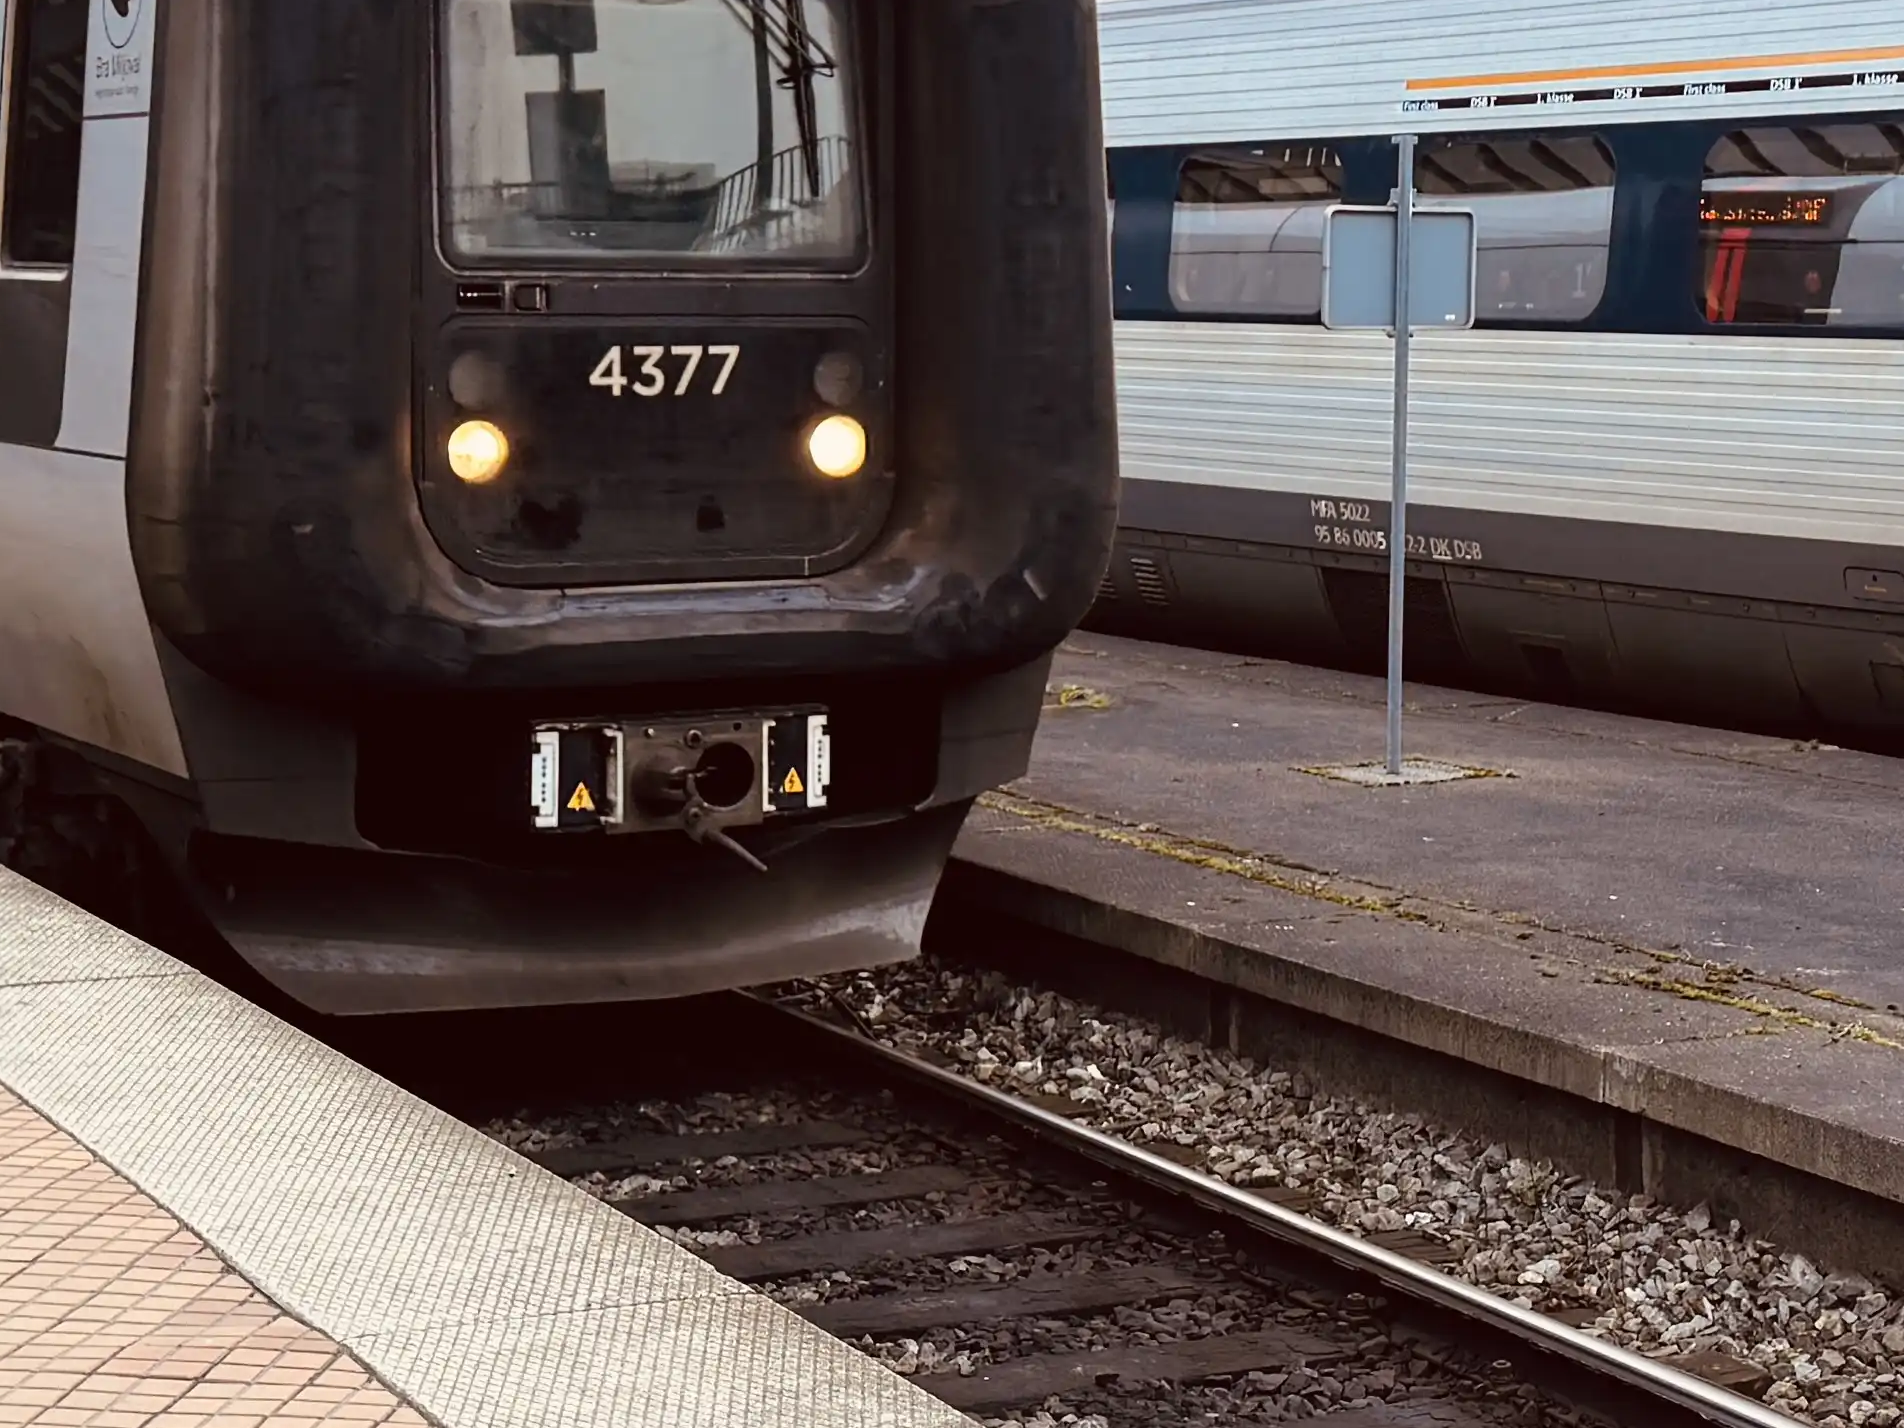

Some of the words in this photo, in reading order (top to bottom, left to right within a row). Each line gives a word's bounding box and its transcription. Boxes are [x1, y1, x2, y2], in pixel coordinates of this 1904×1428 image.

[589, 344, 740, 396] 4377
[1310, 499, 1337, 520] MFA
[1339, 501, 1371, 522] 5022
[1314, 524, 1331, 544] 95
[1334, 527, 1350, 545] 86
[1353, 528, 1386, 550] 0005
[1405, 534, 1427, 554] 2-2
[1430, 537, 1453, 559] DK
[1454, 538, 1483, 560] DSB
